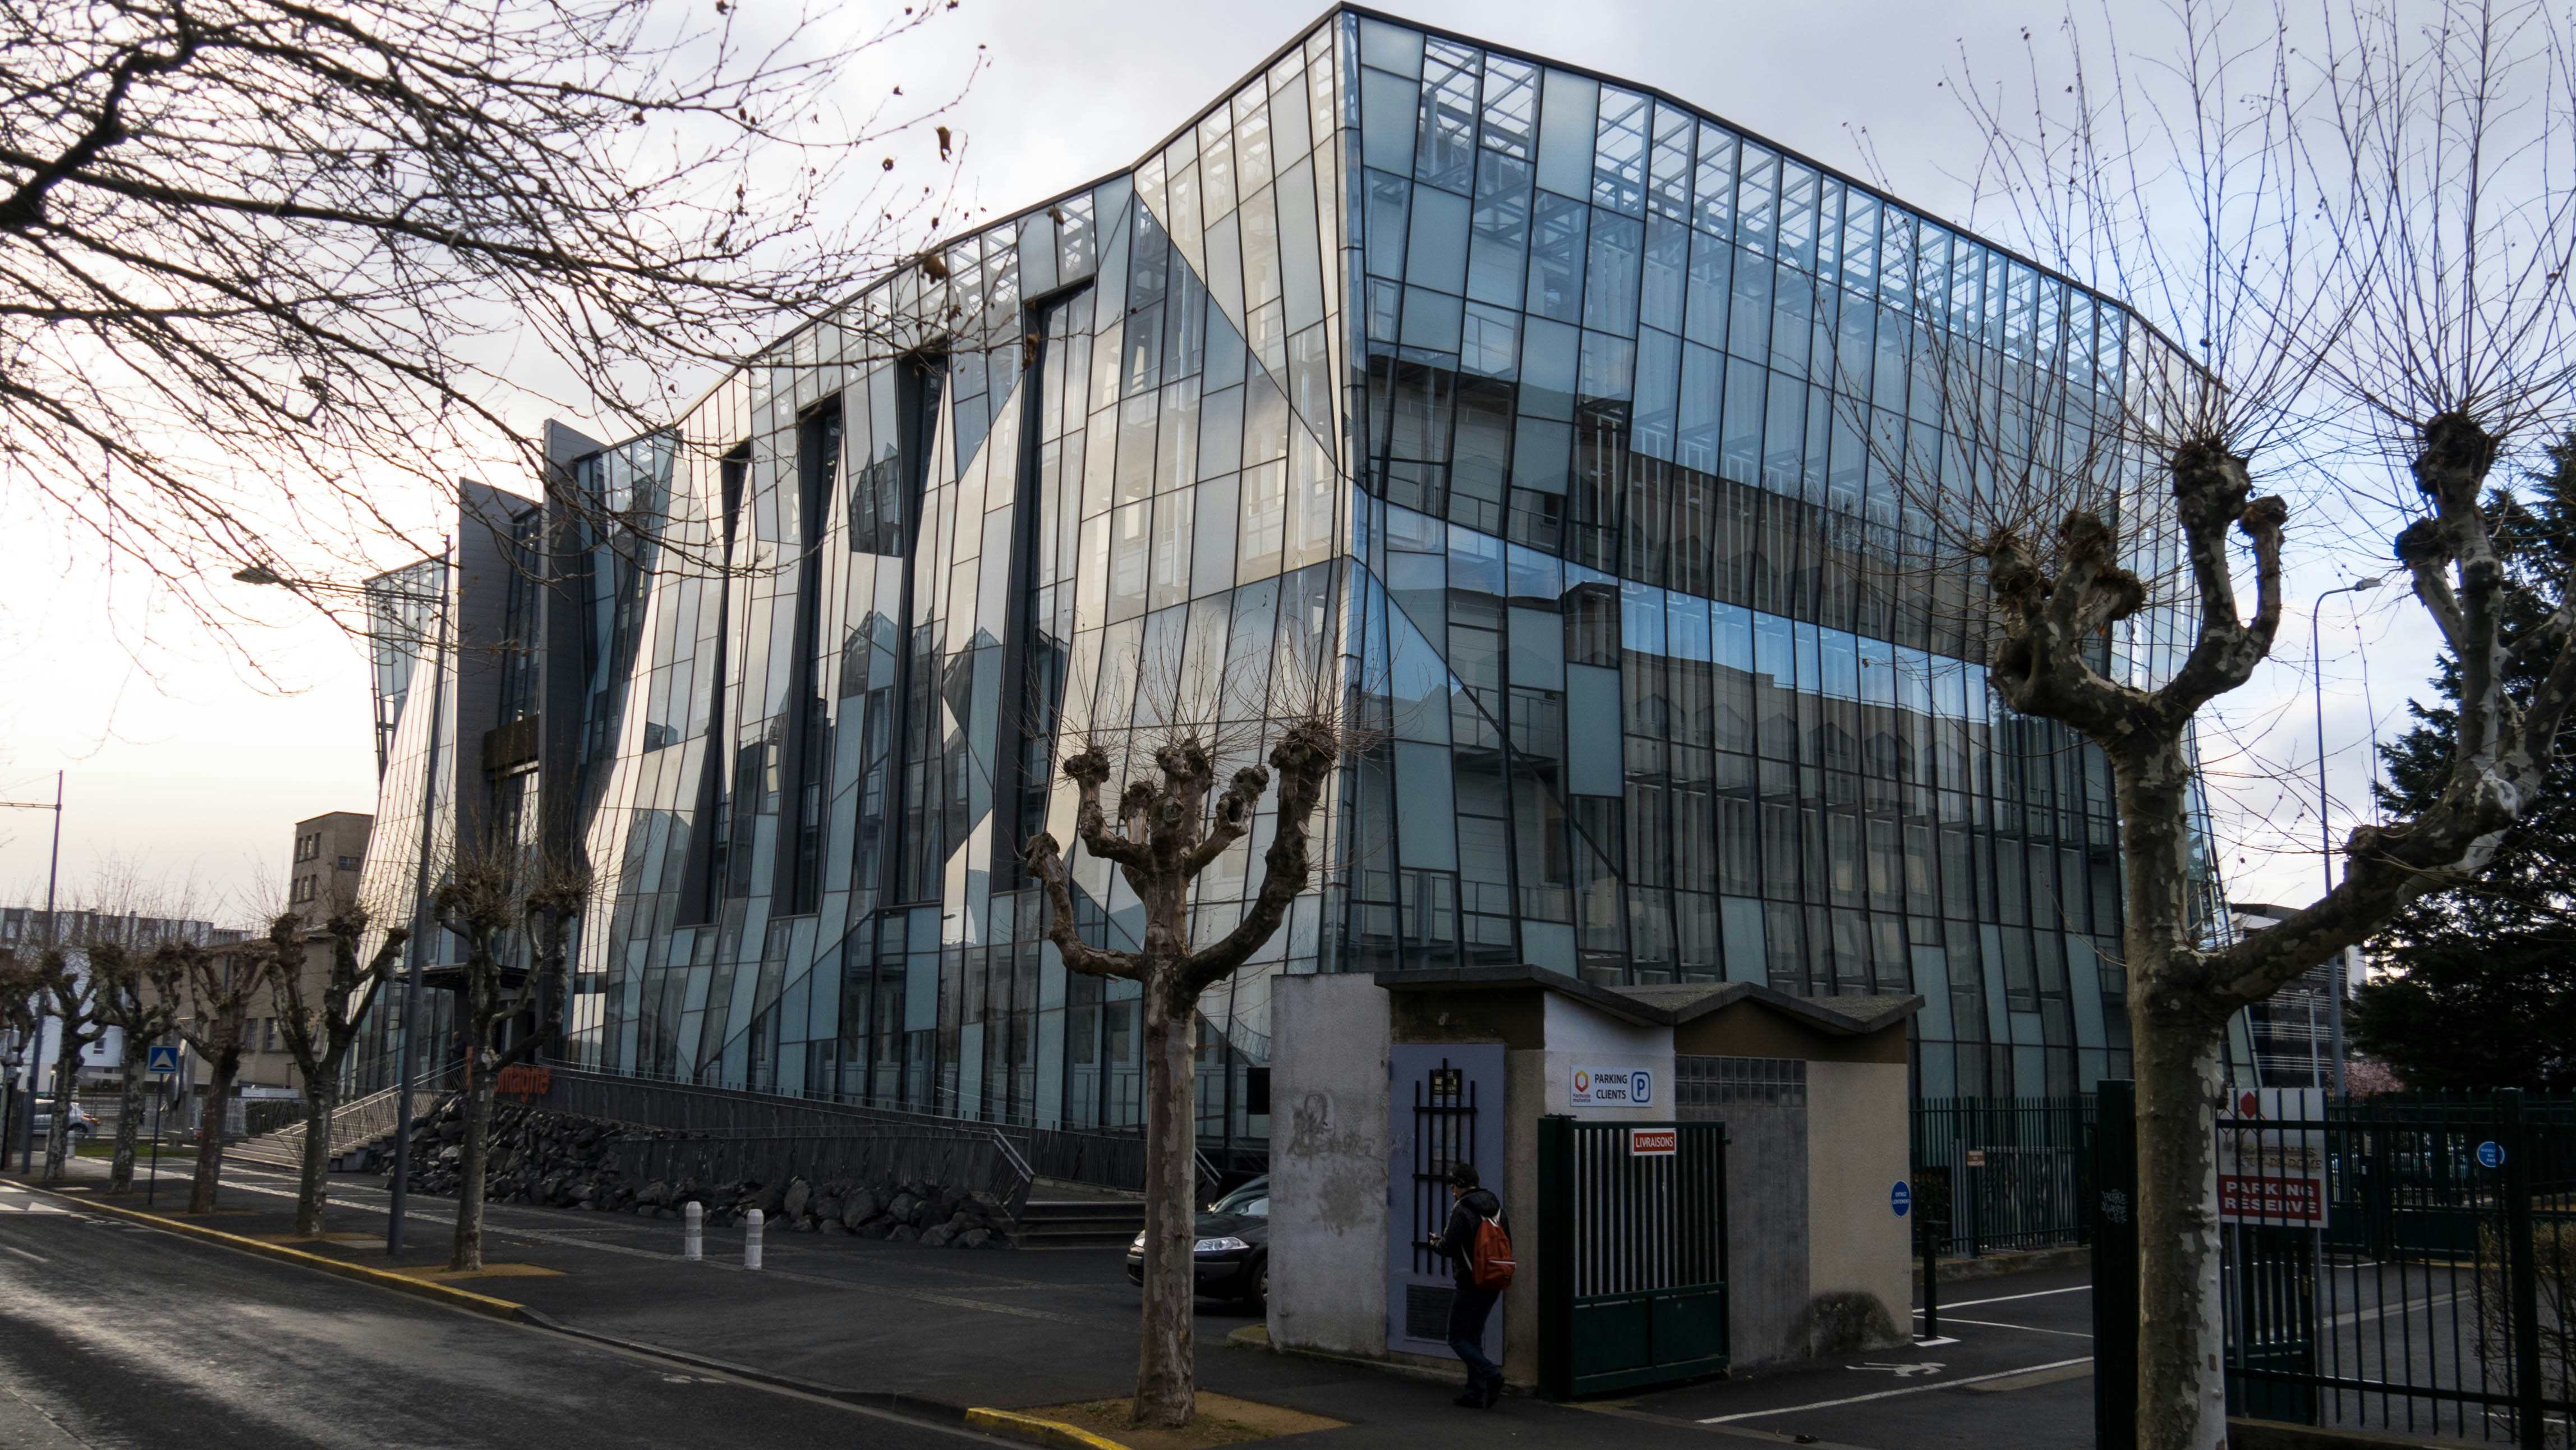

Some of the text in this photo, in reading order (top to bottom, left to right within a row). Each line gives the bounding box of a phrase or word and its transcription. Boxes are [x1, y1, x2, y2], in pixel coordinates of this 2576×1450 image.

[1594, 1073, 1627, 1084] PARKING
[1637, 1079, 1645, 1096] P
[1596, 1089, 1626, 1100] CLIENTS
[1635, 1136, 1673, 1149] LIVRAISONS
